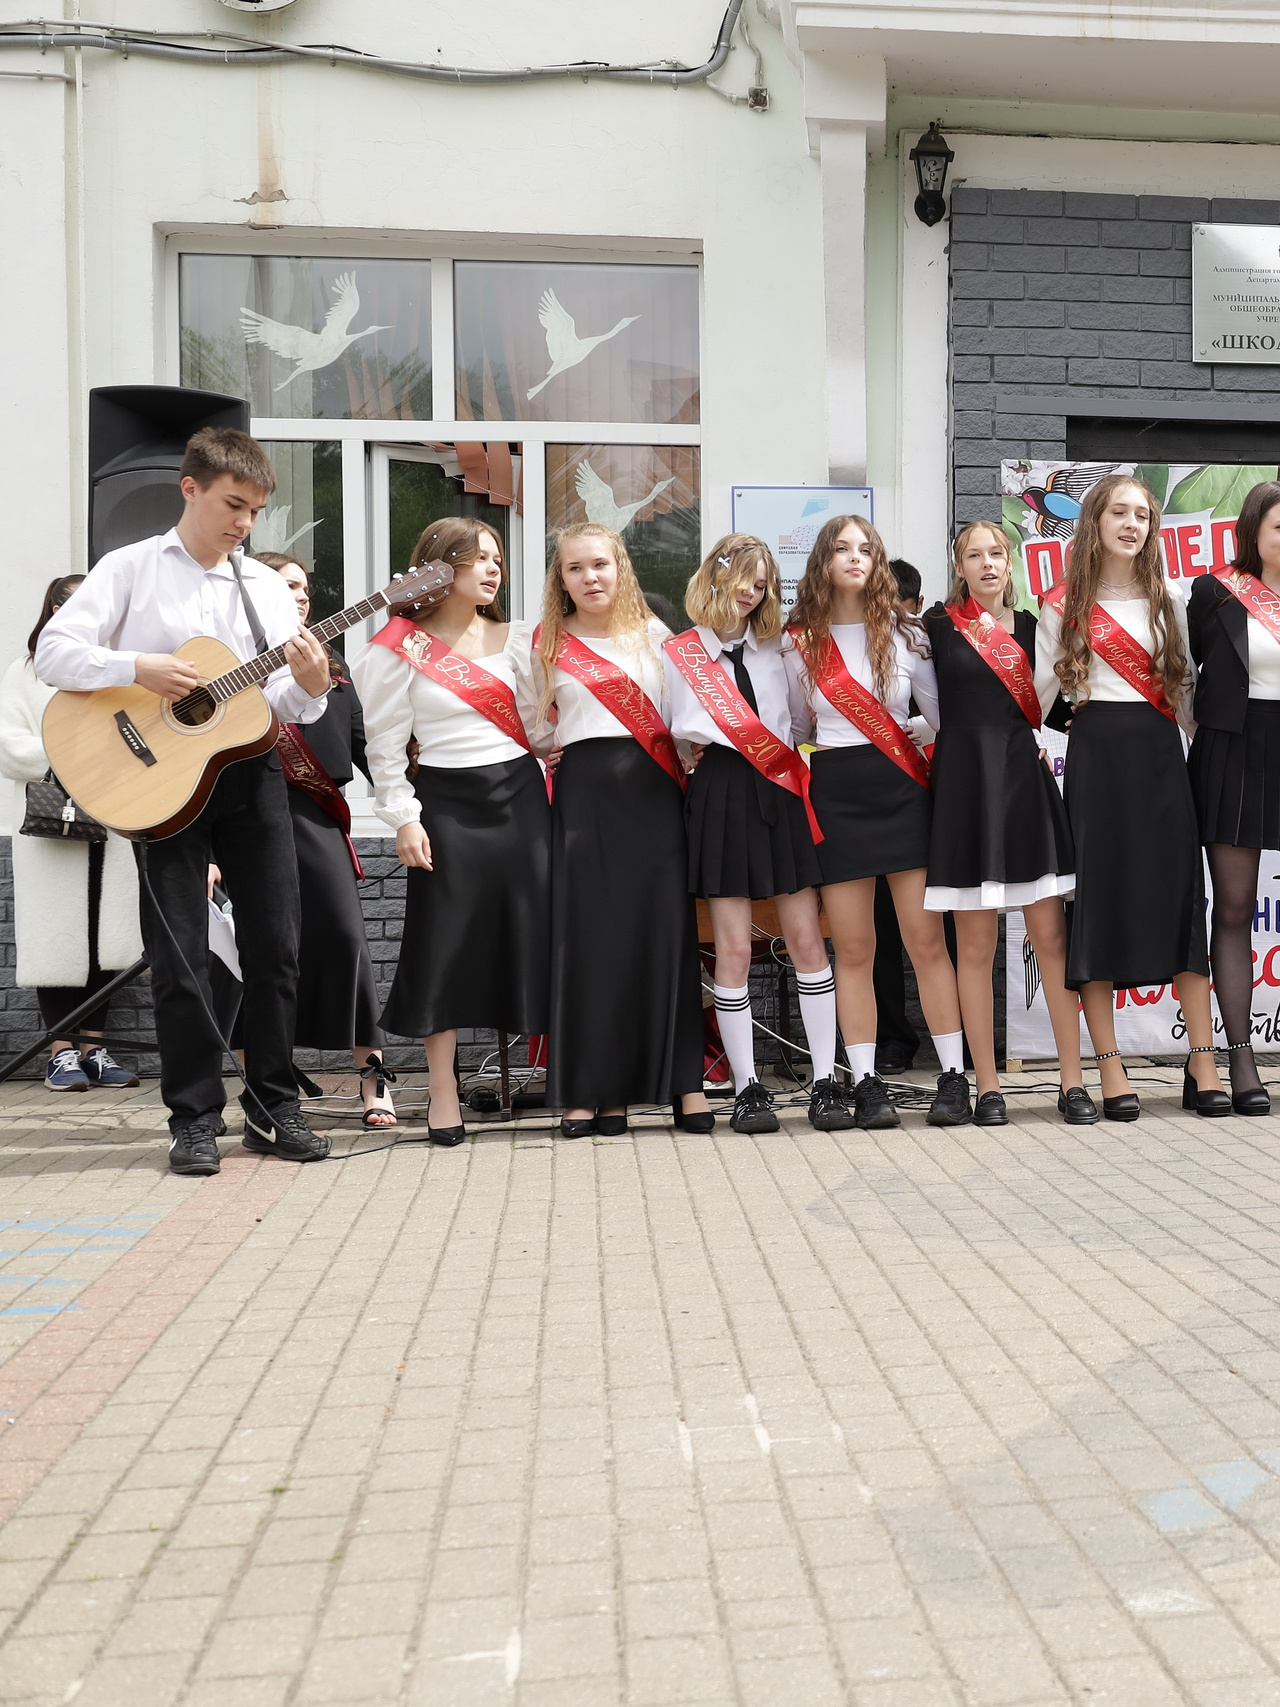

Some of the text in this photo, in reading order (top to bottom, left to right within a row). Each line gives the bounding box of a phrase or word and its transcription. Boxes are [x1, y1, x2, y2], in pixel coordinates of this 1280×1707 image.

[1213, 266, 1271, 275] Администрация
[434, 655, 521, 734] Выпускниц
[569, 651, 656, 738] Выпускница
[677, 641, 748, 739] Выпускница
[818, 653, 892, 742] Выпускница
